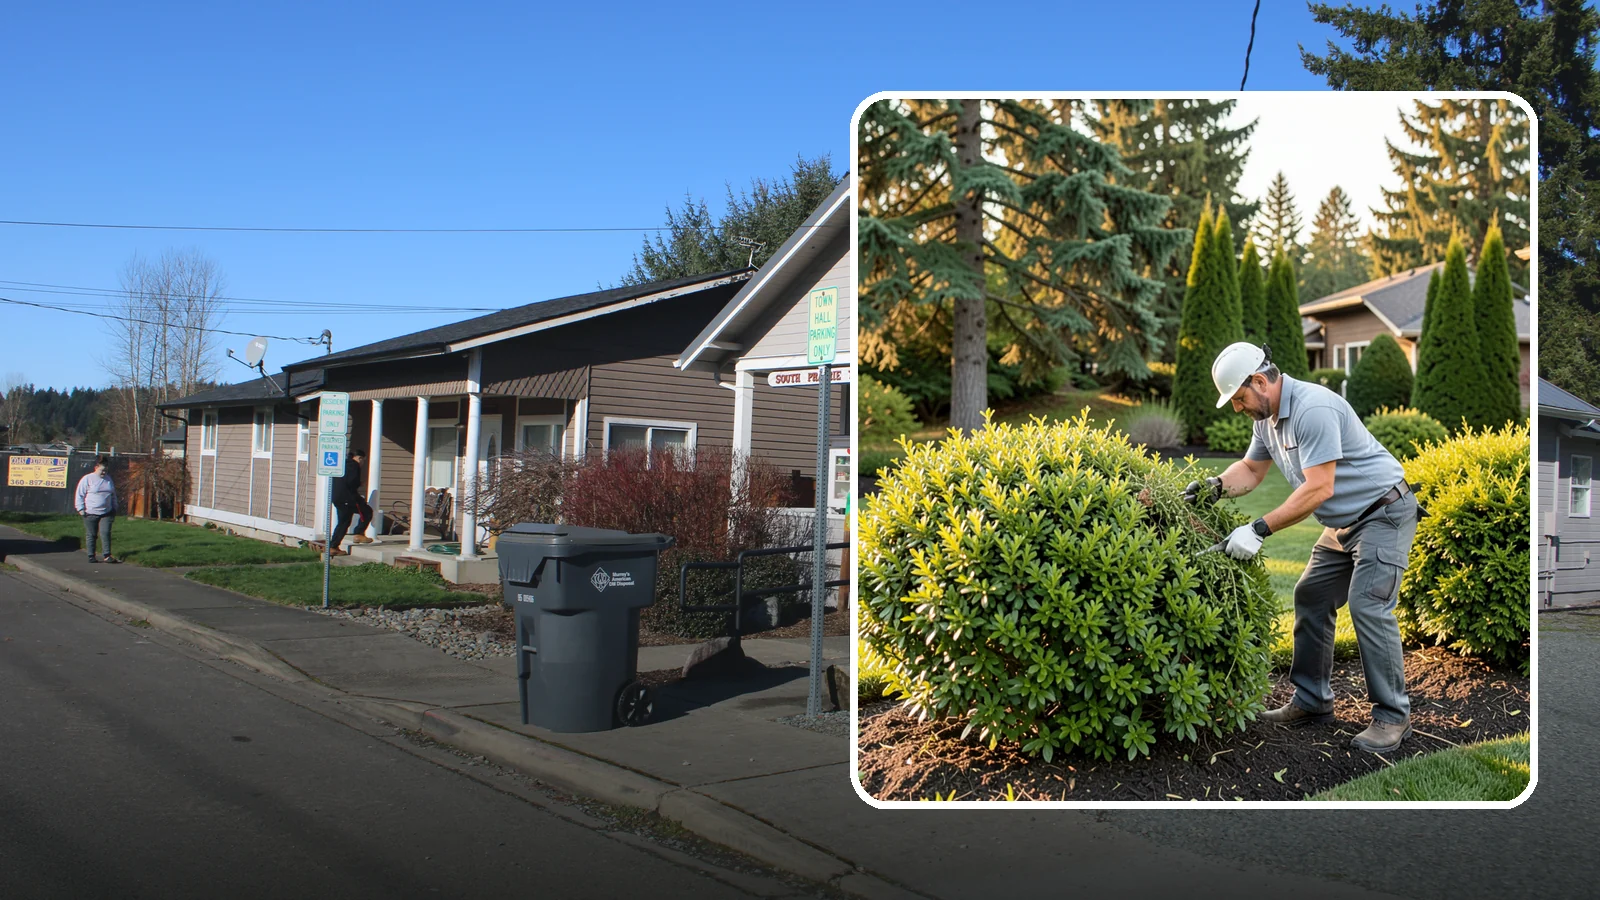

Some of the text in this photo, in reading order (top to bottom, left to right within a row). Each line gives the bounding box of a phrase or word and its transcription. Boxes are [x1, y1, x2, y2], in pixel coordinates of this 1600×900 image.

[815, 294, 833, 308] TOWN
[814, 311, 831, 324] HALL
[810, 326, 836, 341] PARKING
[813, 343, 831, 357] ONLY
[775, 373, 801, 384] SOUTH
[323, 409, 345, 417] PARKING
[325, 420, 340, 428] ONLY
